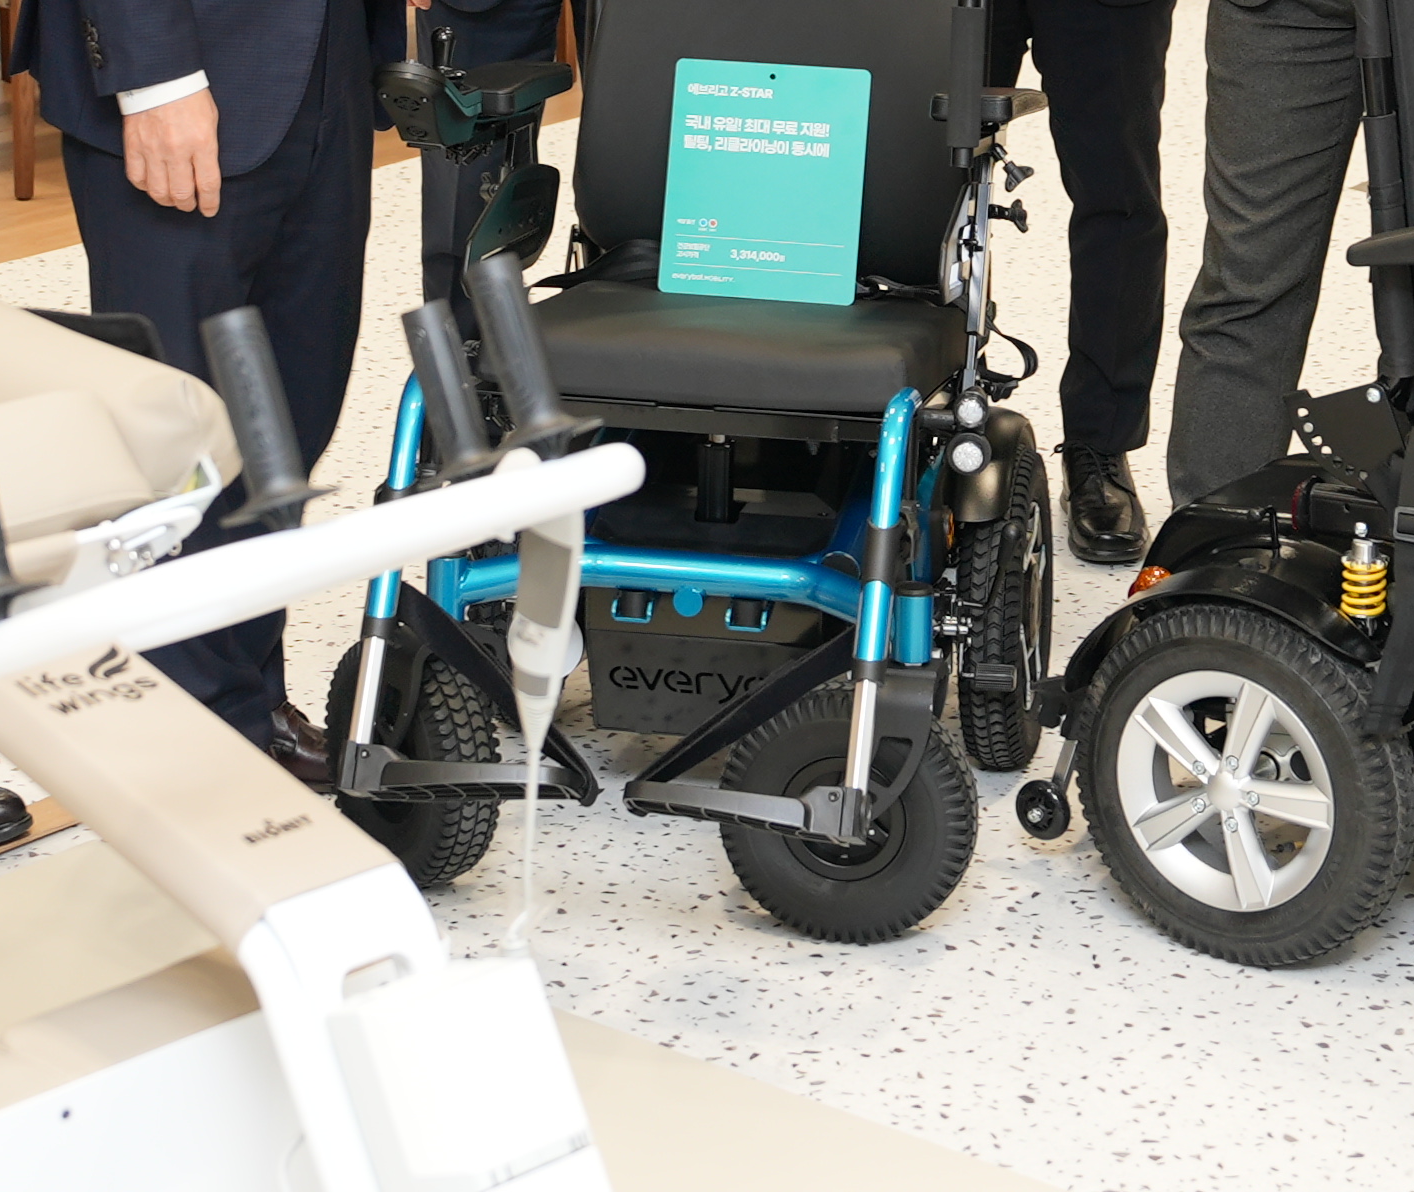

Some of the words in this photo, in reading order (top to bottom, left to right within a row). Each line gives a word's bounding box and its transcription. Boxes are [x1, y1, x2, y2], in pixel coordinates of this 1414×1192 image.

[730, 86, 773, 99] Z-STAR
[685, 114, 711, 130] 국내
[800, 121, 830, 138] 지원!
[50, 676, 159, 715] wings
